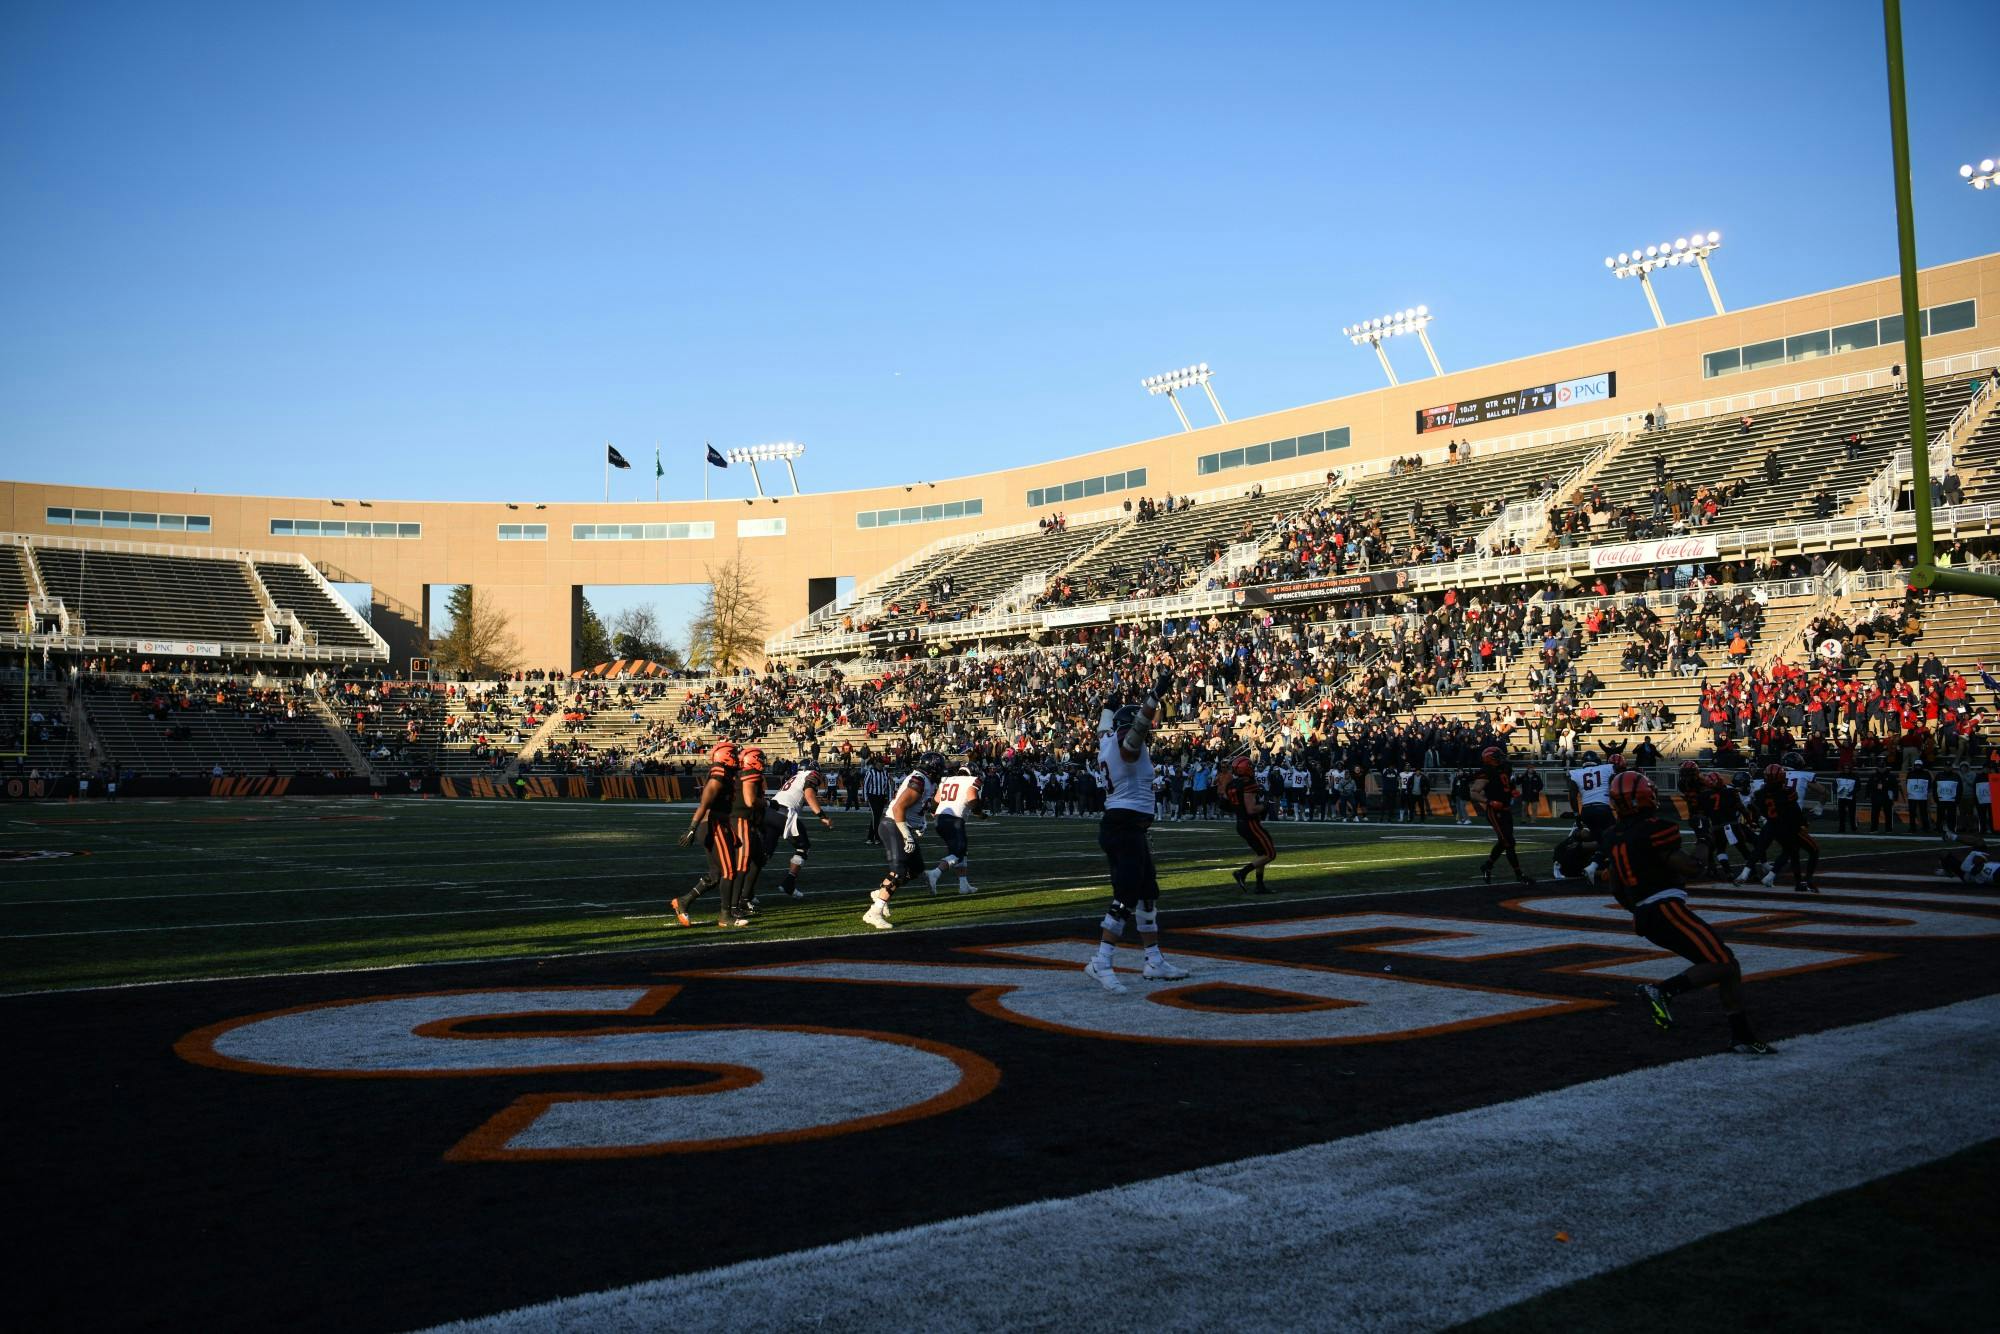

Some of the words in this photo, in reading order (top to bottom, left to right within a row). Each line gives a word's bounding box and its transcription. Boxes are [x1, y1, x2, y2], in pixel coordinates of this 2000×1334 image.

[1575, 381, 1606, 399] PNC
[1502, 397, 1516, 405] 4TH
[1532, 396, 1539, 407] 7
[1460, 404, 1477, 414] 10:37
[1436, 415, 1447, 425] 19
[1486, 411, 1500, 419] BALL
[1266, 586, 1280, 594] DON'T
[1320, 580, 1338, 588] ACTION
[1338, 578, 1350, 586] THIS
[1350, 576, 1371, 585] SEASON
[154, 644, 173, 652] PNC
[196, 646, 214, 654] PNC
[1295, 775, 1302, 784] 19
[1583, 770, 1602, 791] 61
[939, 783, 960, 802] 50
[1611, 841, 1639, 887] 11
